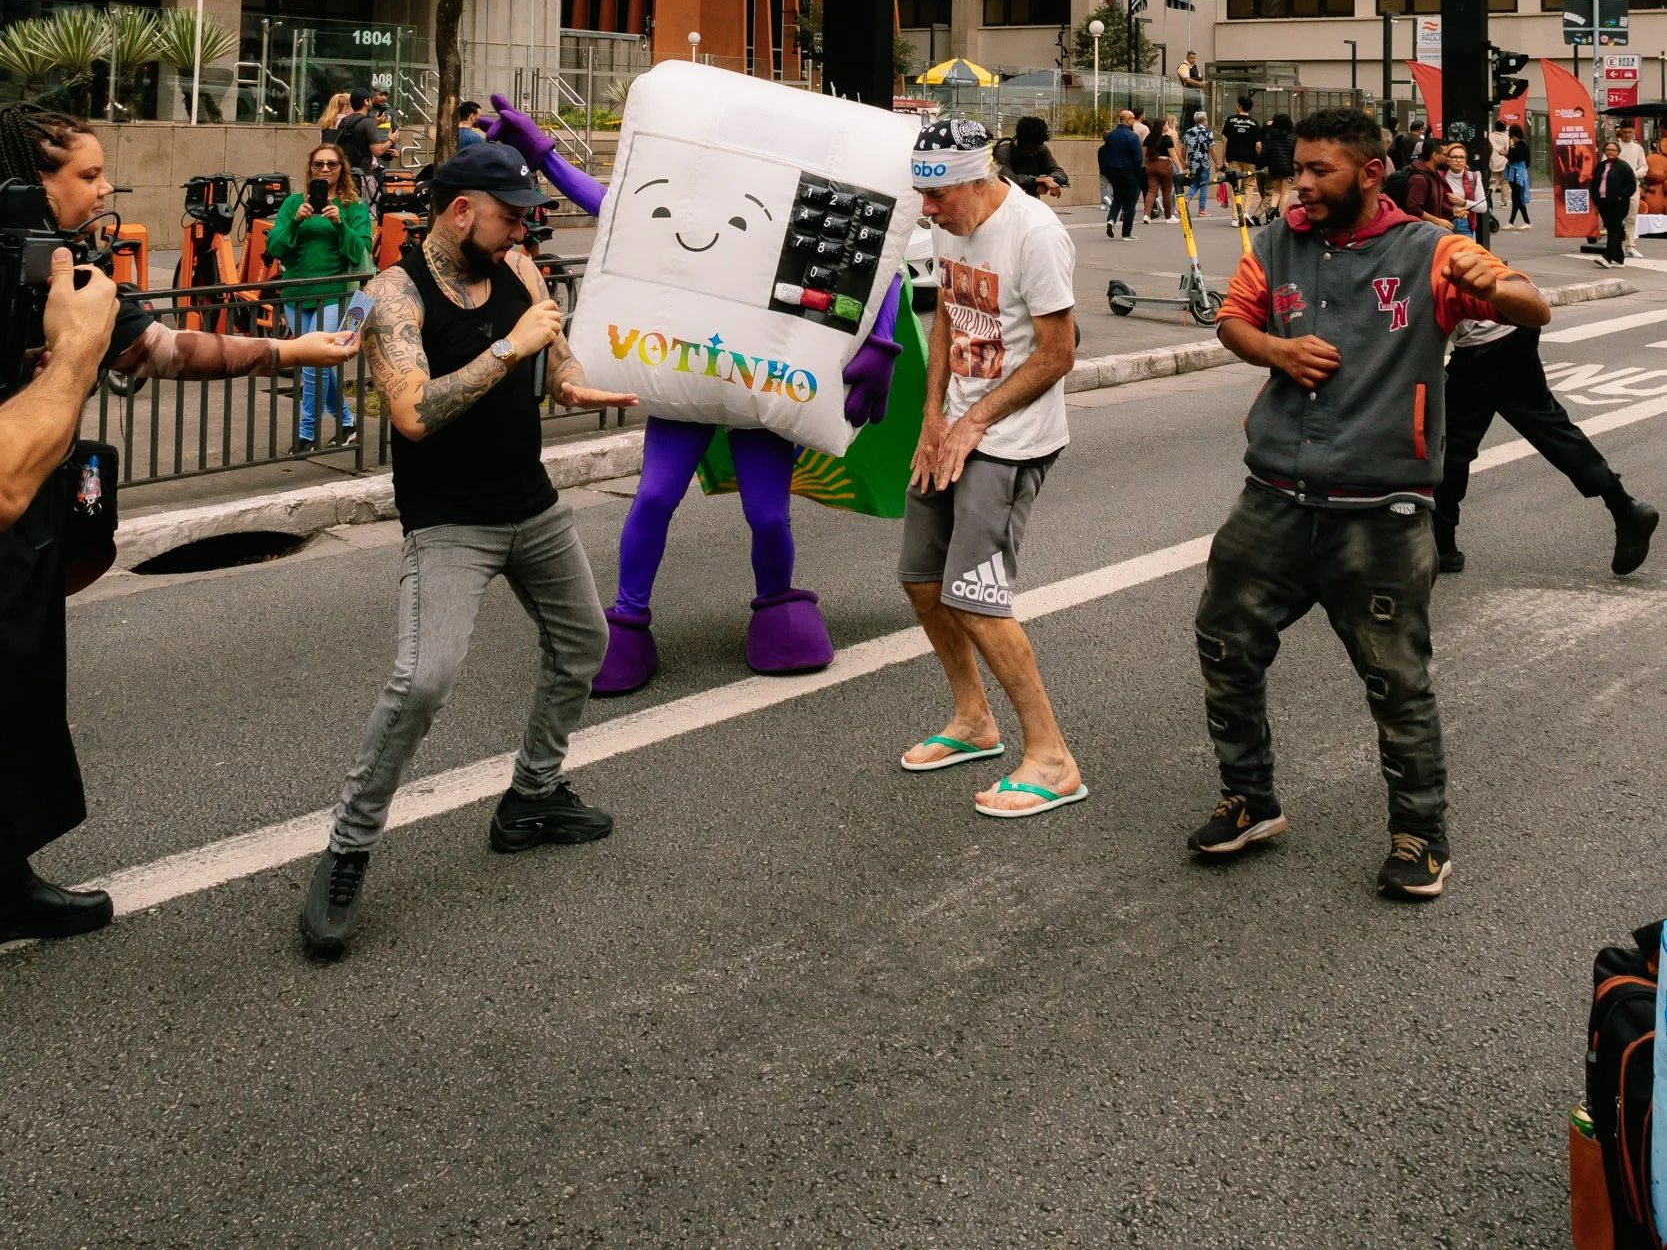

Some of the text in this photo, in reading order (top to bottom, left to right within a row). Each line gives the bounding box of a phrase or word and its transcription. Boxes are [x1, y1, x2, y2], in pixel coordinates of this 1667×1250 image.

[353, 30, 392, 46] 1804
[807, 188, 813, 198] 1
[829, 195, 838, 206] 2
[801, 209, 809, 219] 4
[865, 206, 874, 217] 3
[823, 217, 831, 228] 5
[860, 229, 869, 239] 6
[795, 236, 803, 247] 7
[817, 243, 825, 253] 8
[854, 253, 863, 263] 9
[810, 266, 817, 278] 0
[608, 324, 818, 403] VOTINHO
[951, 580, 1014, 605] adidas
